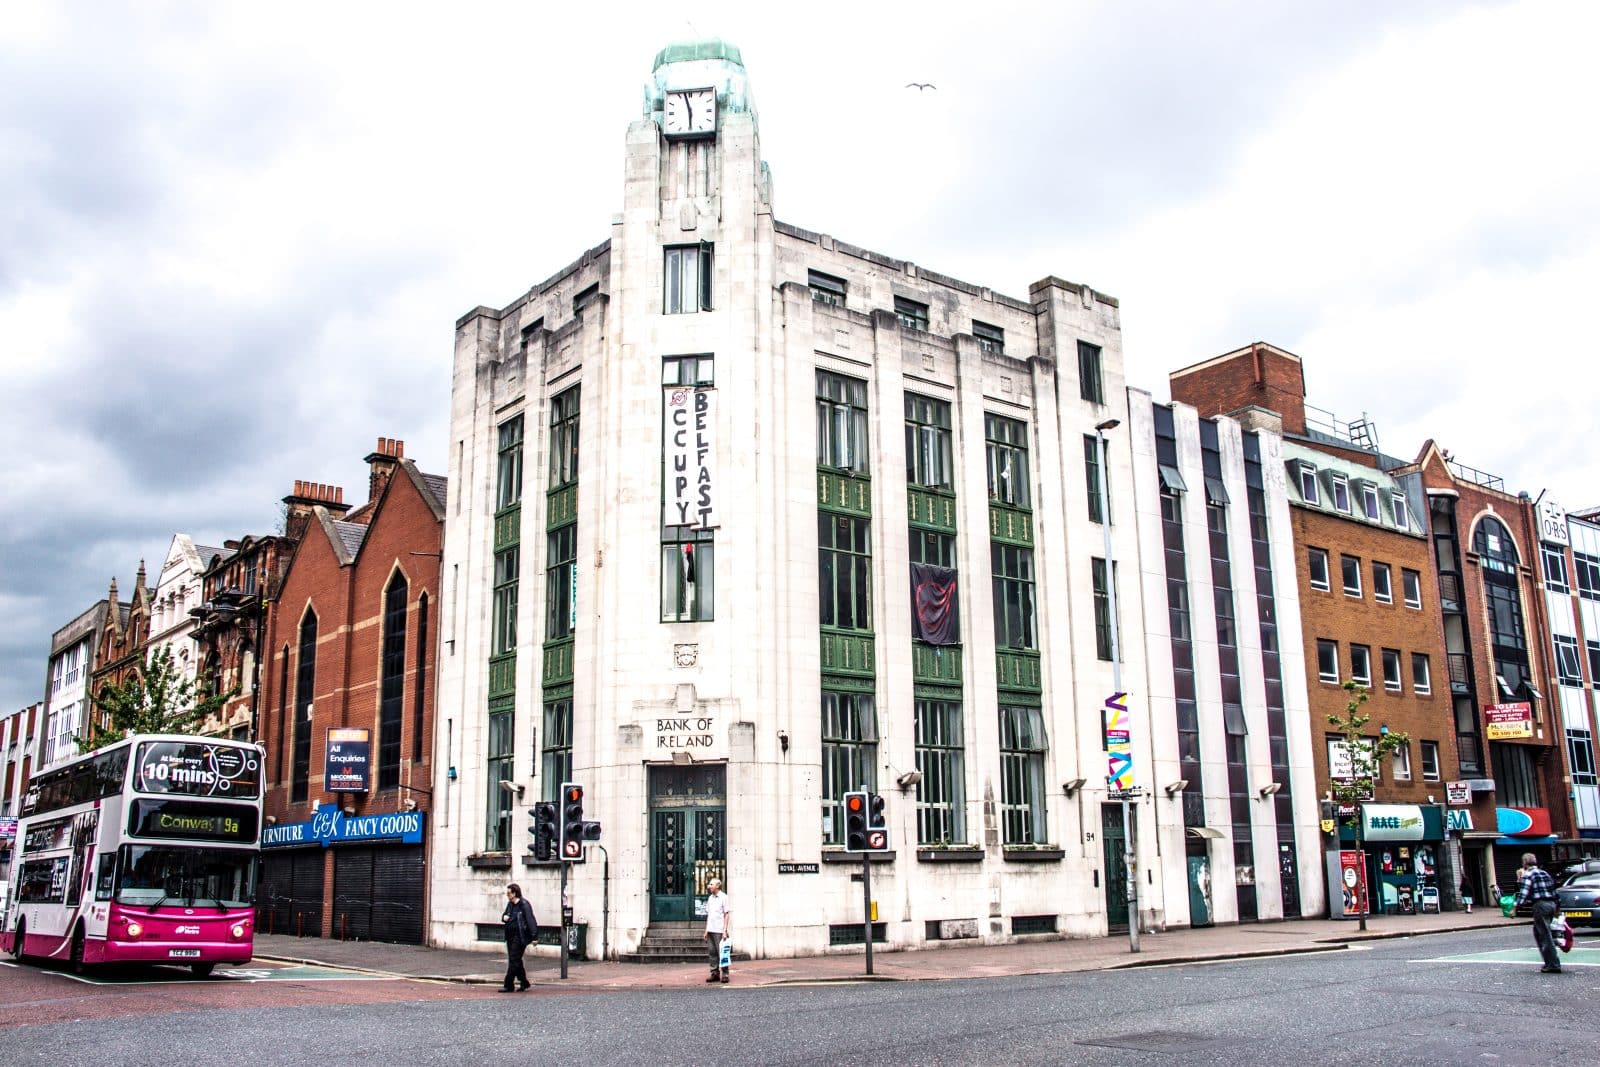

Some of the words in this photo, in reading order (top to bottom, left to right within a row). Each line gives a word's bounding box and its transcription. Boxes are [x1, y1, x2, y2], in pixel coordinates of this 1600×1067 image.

[695, 392, 713, 528] BELFAST
[657, 719, 691, 731] BANK
[697, 718, 713, 731] OF
[657, 735, 713, 748] IRELAND
[169, 755, 184, 763] least
[185, 758, 203, 766] every
[330, 755, 366, 763] Enquiries
[145, 763, 169, 780] 10
[172, 765, 215, 784] mins
[224, 818, 238, 833] 9a
[345, 818, 378, 836] FANCY
[381, 814, 418, 834] GOODS
[1370, 816, 1400, 829] MACE
[1086, 832, 1095, 841] 94
